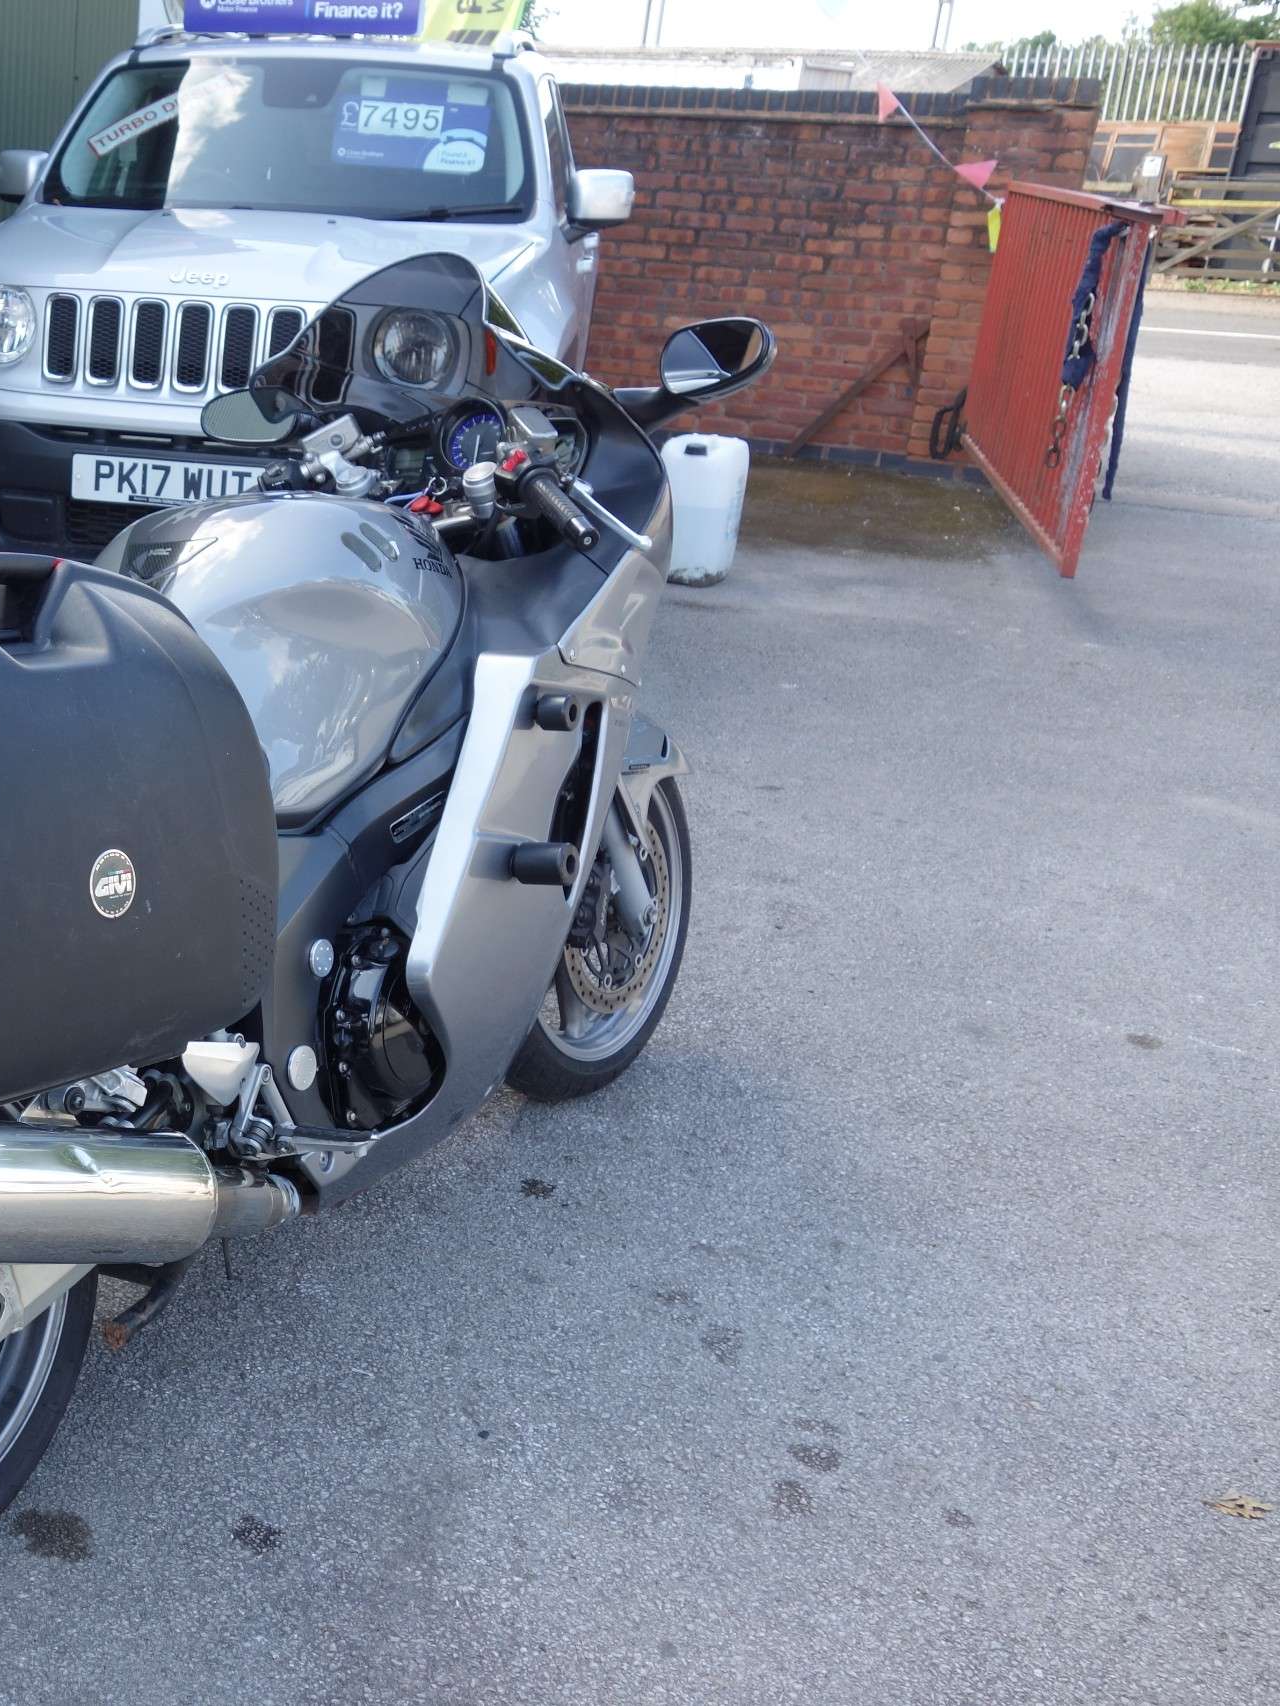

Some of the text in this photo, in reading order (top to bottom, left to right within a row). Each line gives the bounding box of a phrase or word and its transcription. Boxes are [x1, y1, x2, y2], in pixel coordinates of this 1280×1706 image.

[314, 2, 404, 18] Finance it?
[95, 110, 157, 147] TURBO
[169, 265, 230, 289] Jeep
[94, 459, 252, 500] PK17 WUT
[412, 557, 453, 578] HONDA
[95, 873, 132, 897] GIVI
